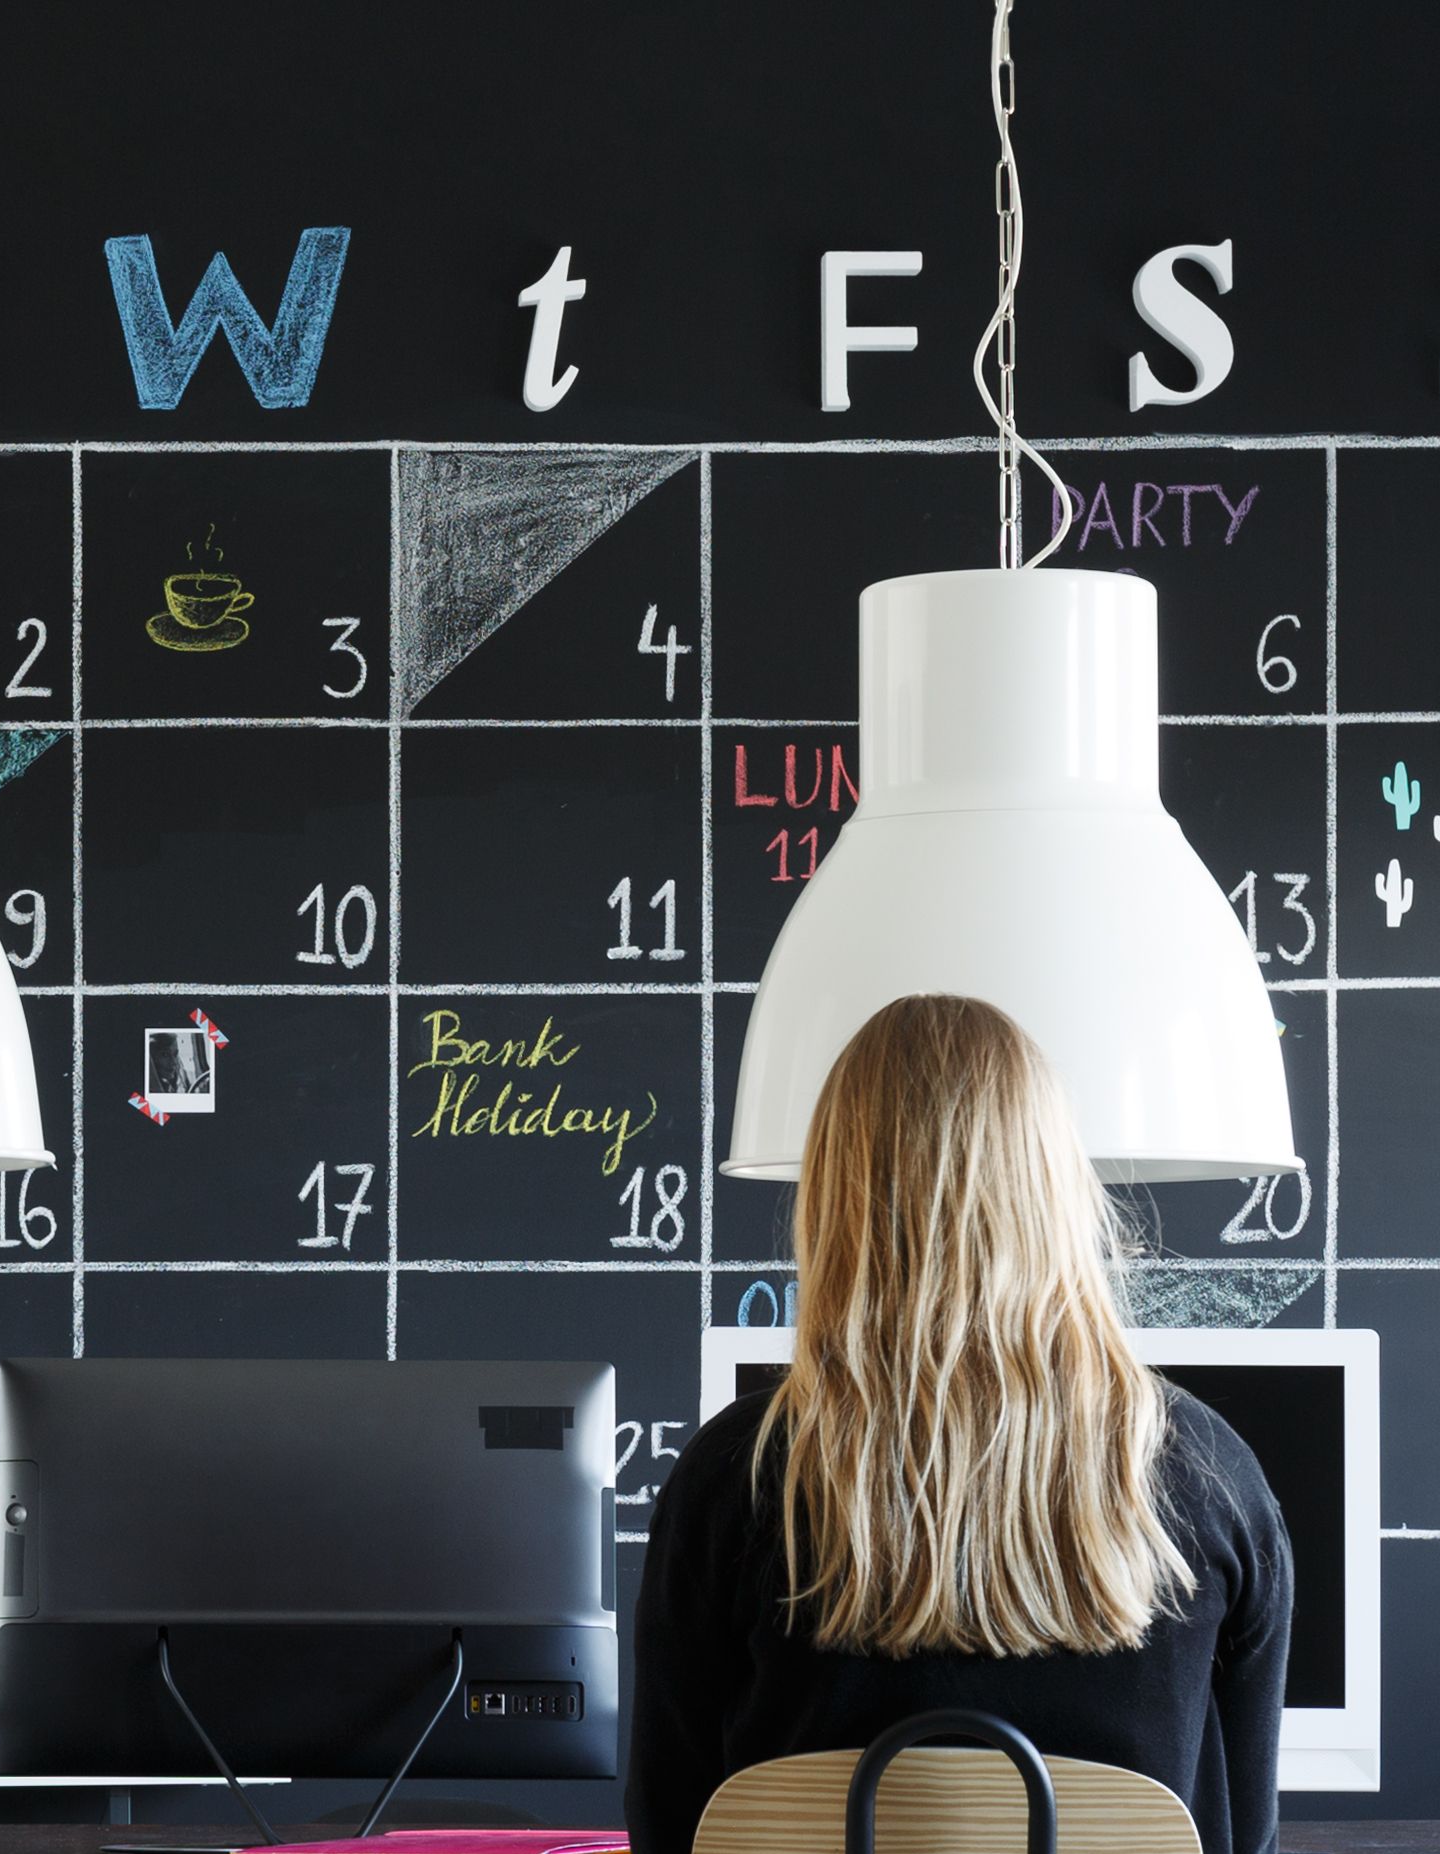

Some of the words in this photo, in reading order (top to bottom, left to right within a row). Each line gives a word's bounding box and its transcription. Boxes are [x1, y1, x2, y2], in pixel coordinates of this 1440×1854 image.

[104, 226, 351, 410] W
[519, 246, 586, 412] t
[821, 251, 923, 412] F
[1129, 239, 1234, 412] S
[1051, 481, 1260, 552] PARTY
[6, 618, 52, 700] 2
[322, 617, 367, 698] 3
[638, 604, 691, 701] 4
[1257, 614, 1301, 693] 6
[6, 889, 47, 968] 9
[296, 883, 377, 969] 10
[607, 877, 686, 961] 11
[1229, 870, 1316, 965] 13
[408, 1010, 581, 1078] Bank
[412, 1069, 657, 1177] Holiday
[297, 1161, 375, 1251] 17
[609, 1164, 688, 1253] 18
[1221, 1169, 1312, 1244] 20
